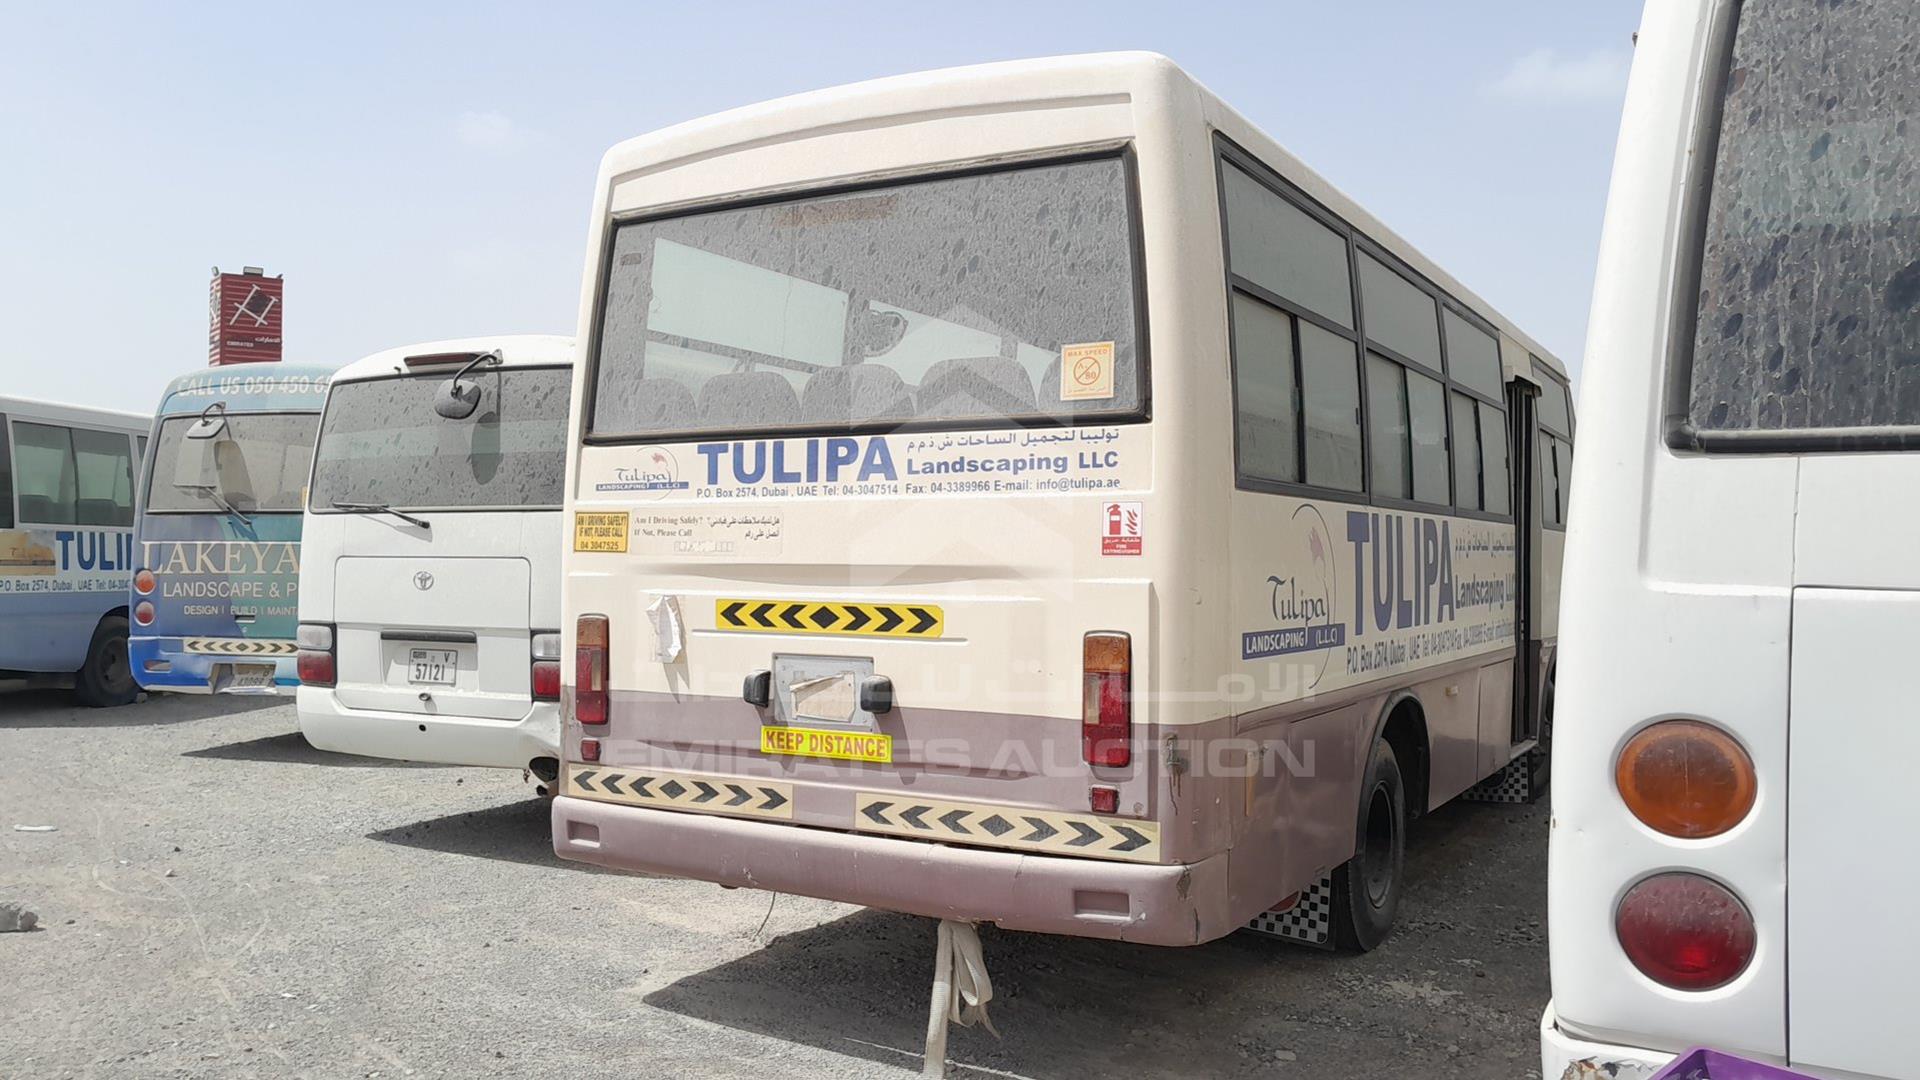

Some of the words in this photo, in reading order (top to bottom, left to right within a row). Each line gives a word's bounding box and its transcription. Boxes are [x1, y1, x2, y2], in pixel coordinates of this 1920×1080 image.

[178, 377, 215, 396] CALL
[220, 376, 241, 395] US
[244, 376, 274, 394] 050
[279, 375, 309, 394] 450
[697, 436, 898, 485] TULIPA
[907, 453, 1068, 475] Landscaping
[1079, 451, 1118, 468] LLC
[716, 487, 733, 498] Box
[762, 486, 789, 497] Dubai
[797, 485, 817, 496] UAE
[823, 485, 839, 496] Tel:
[842, 484, 898, 496] 04-3047514
[906, 482, 928, 494] Fax:
[930, 480, 990, 493] 04-3389966
[994, 479, 1032, 492] E-mail:
[1036, 477, 1121, 492] info@tulipa.ae
[653, 516, 678, 526] Driving
[595, 527, 611, 537] PLEASE
[612, 527, 623, 537] CALL
[657, 529, 677, 537] Please
[678, 529, 692, 537] Call
[56, 531, 133, 570] TULI
[1347, 511, 1455, 636] TULIPA
[16, 581, 29, 592] Box
[78, 580, 92, 591] UAE
[163, 581, 263, 598] LANDSCAPE
[269, 582, 280, 598] &
[1456, 573, 1504, 612] Landscaping
[184, 605, 219, 615] DESIGN
[231, 605, 257, 616] BUILD
[1267, 576, 1326, 627] Tulipa
[1246, 631, 1304, 654] LANDSCAPING
[444, 652, 450, 662] V
[1361, 644, 1372, 672] Box
[416, 663, 445, 681] 57121
[766, 731, 804, 750] KEEP
[809, 733, 886, 757] DISTANCE
